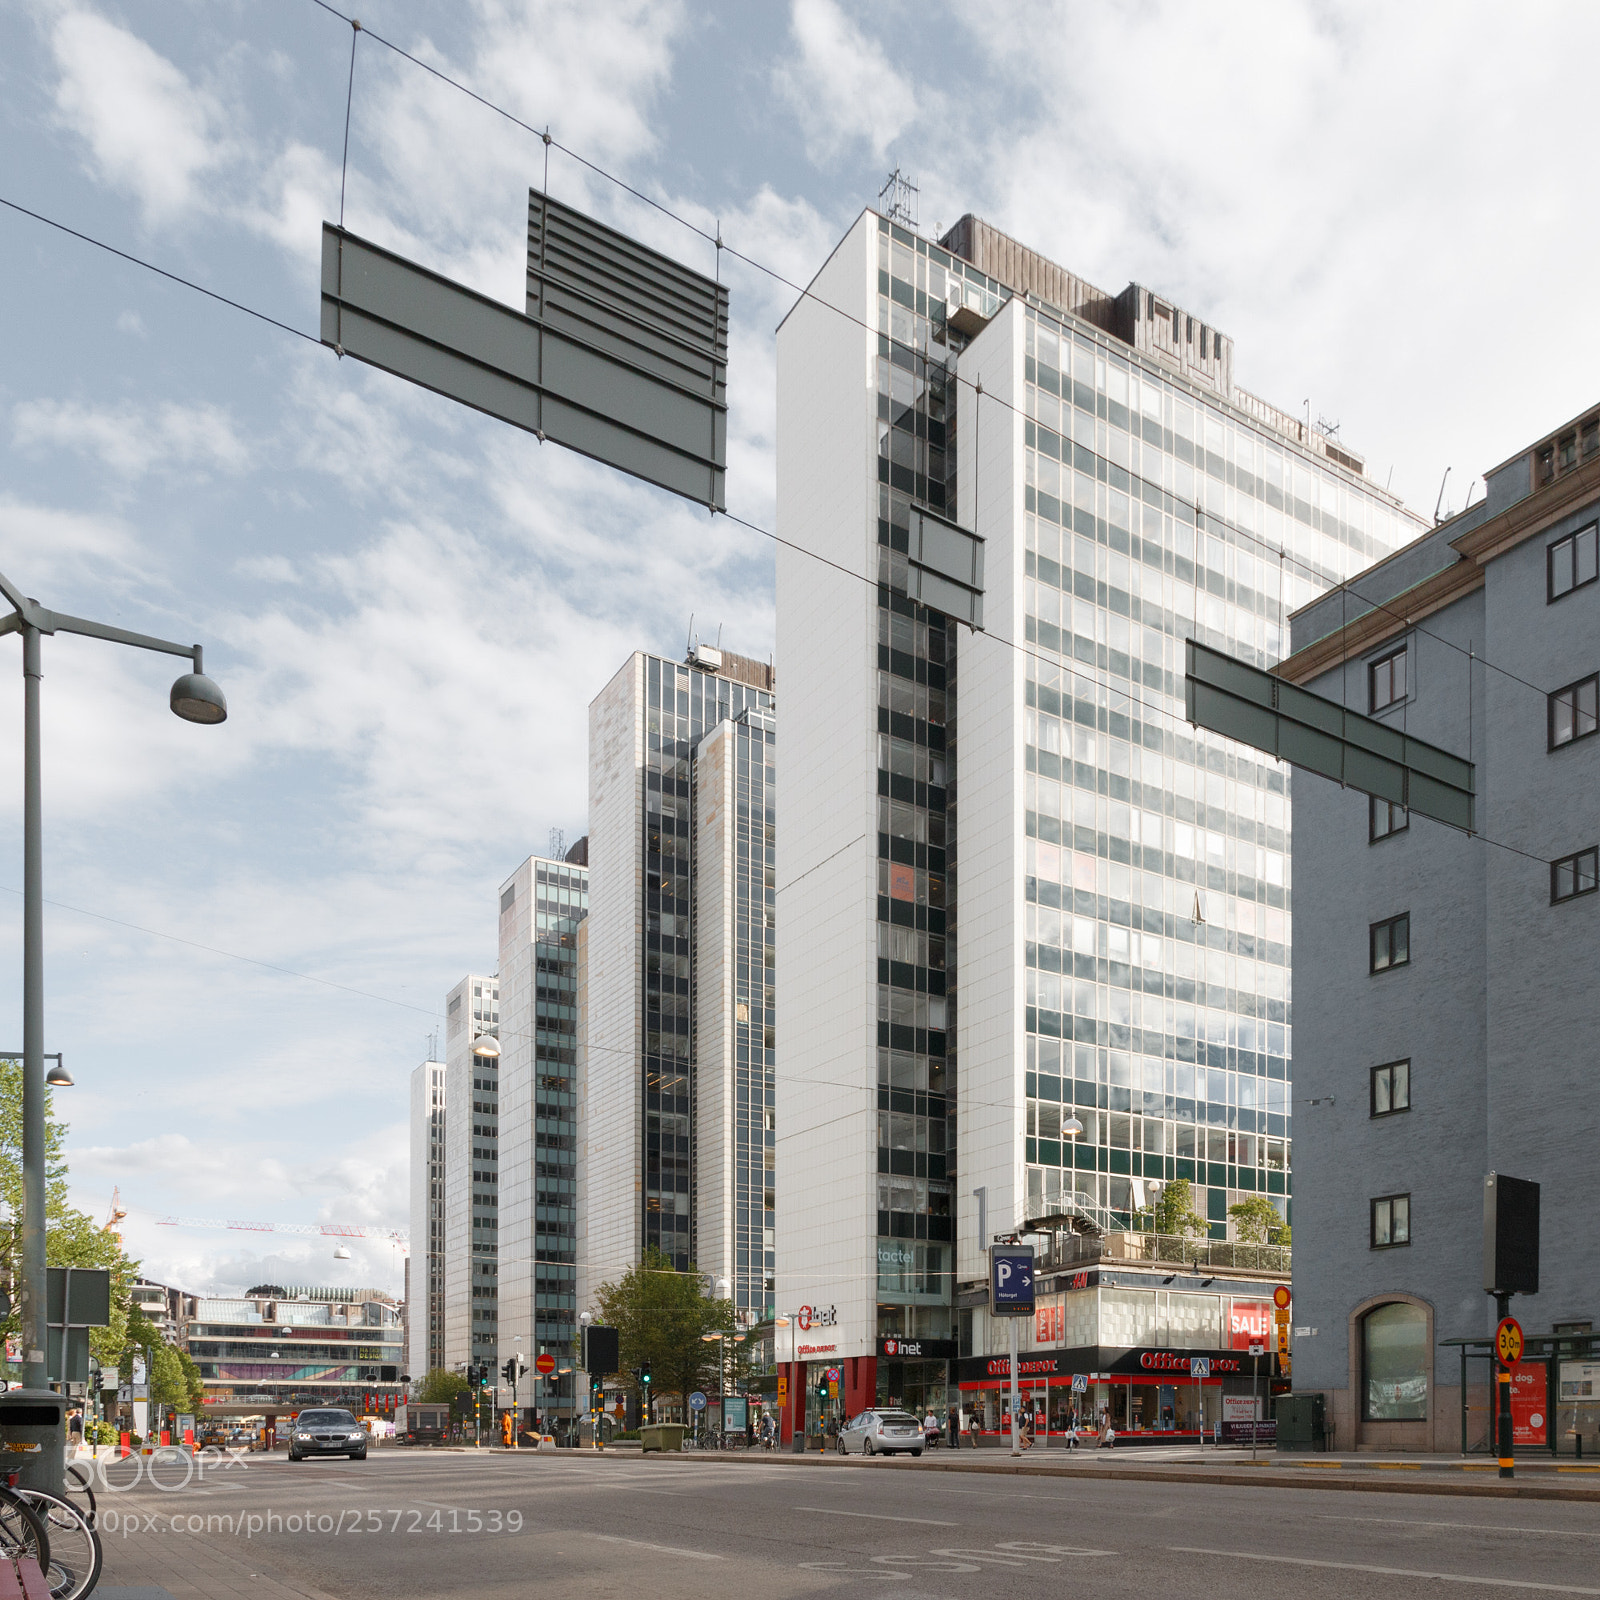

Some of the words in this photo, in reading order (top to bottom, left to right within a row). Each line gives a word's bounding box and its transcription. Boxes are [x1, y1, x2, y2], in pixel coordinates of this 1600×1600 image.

[878, 1248, 914, 1263] tactel
[998, 1264, 1011, 1287] P
[1072, 1271, 1088, 1289] H&M
[1231, 1315, 1267, 1335] SALE
[797, 1345, 816, 1354] Office
[898, 1341, 922, 1355] Inet
[1140, 1352, 1191, 1370] Office
[1515, 1373, 1535, 1384] dog.
